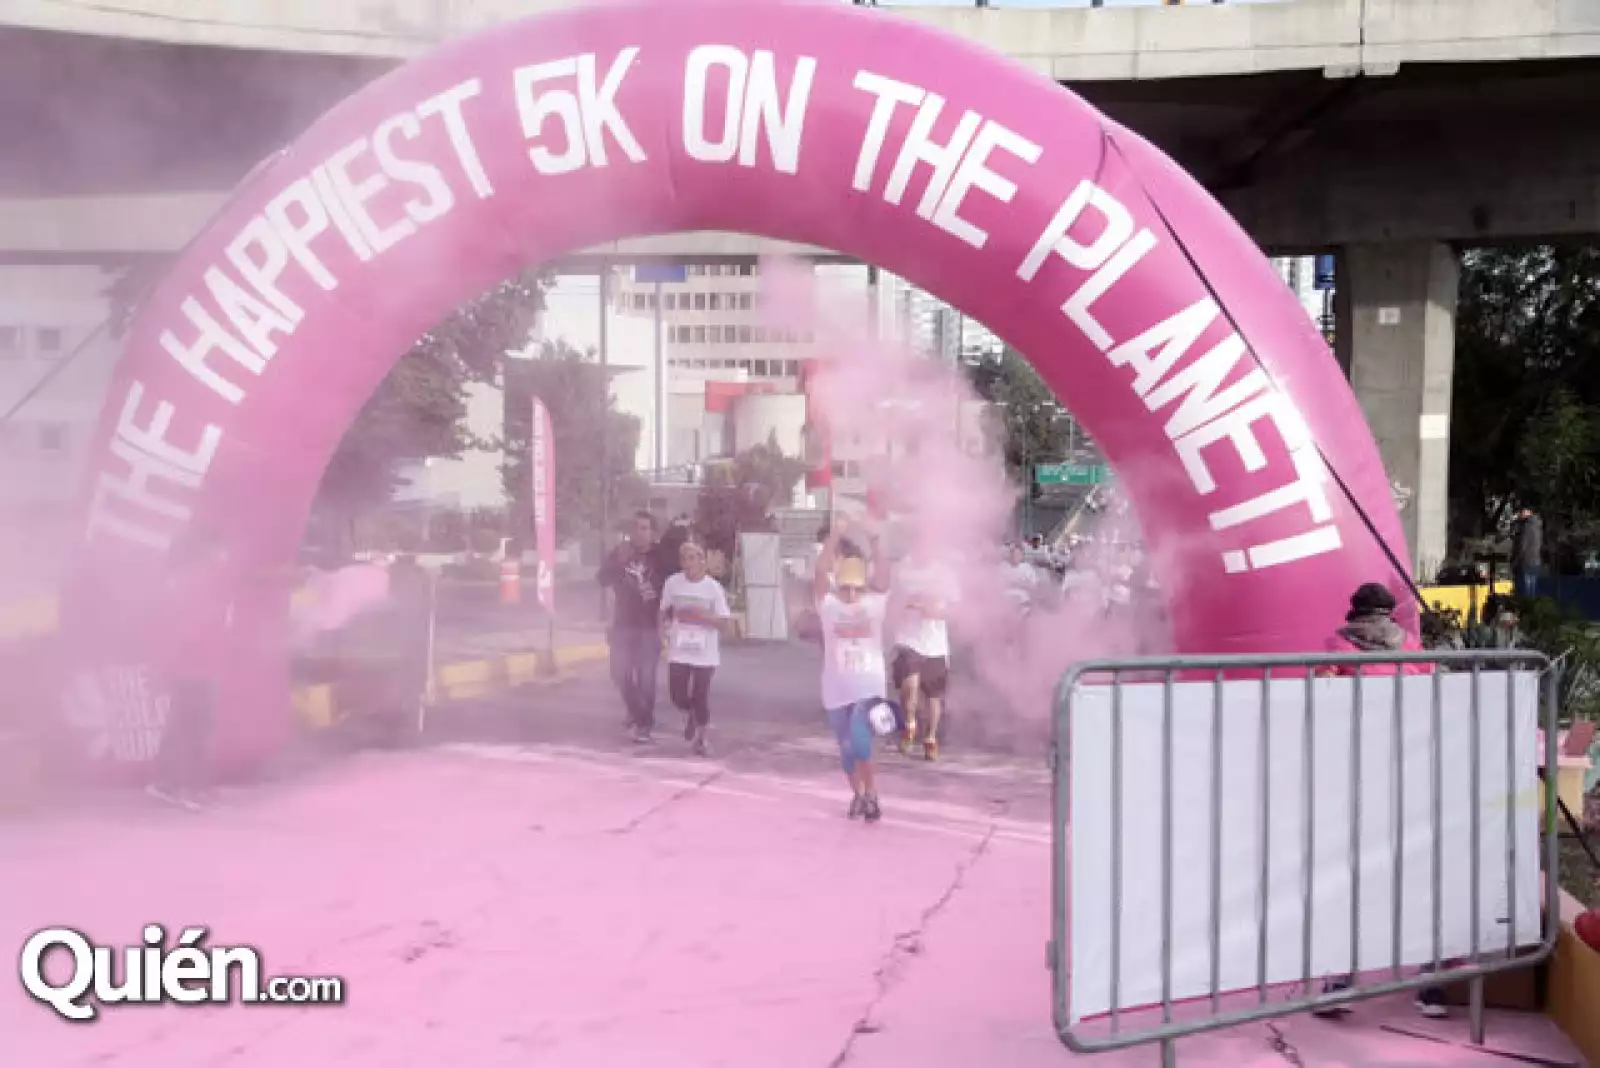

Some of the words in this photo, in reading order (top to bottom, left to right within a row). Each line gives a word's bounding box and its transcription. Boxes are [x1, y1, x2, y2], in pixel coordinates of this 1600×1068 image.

[86, 380, 222, 549] THE
[160, 79, 494, 403] HAPPIEST
[513, 46, 646, 174] 5K
[682, 44, 816, 174] ON
[853, 71, 1043, 249] THE
[1015, 179, 1343, 574] PLANET!
